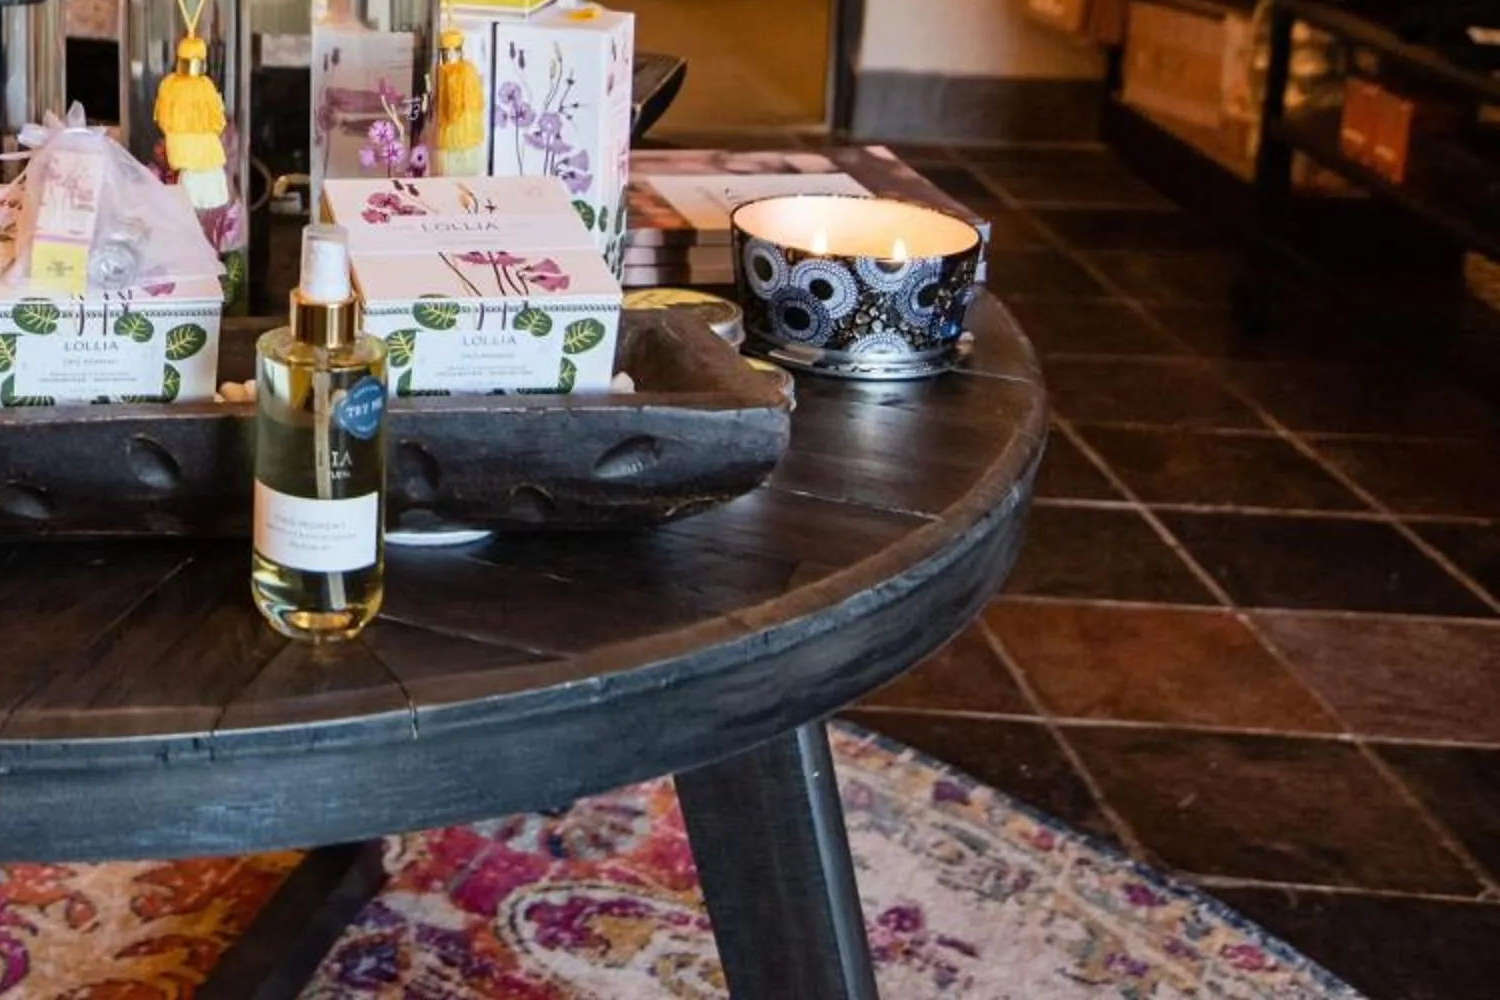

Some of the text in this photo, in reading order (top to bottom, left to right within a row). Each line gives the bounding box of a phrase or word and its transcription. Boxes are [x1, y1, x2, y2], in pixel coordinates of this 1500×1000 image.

[420, 221, 500, 233] LOLLIA
[64, 341, 119, 352] LOLLIA
[462, 335, 517, 347] LOLLIA
